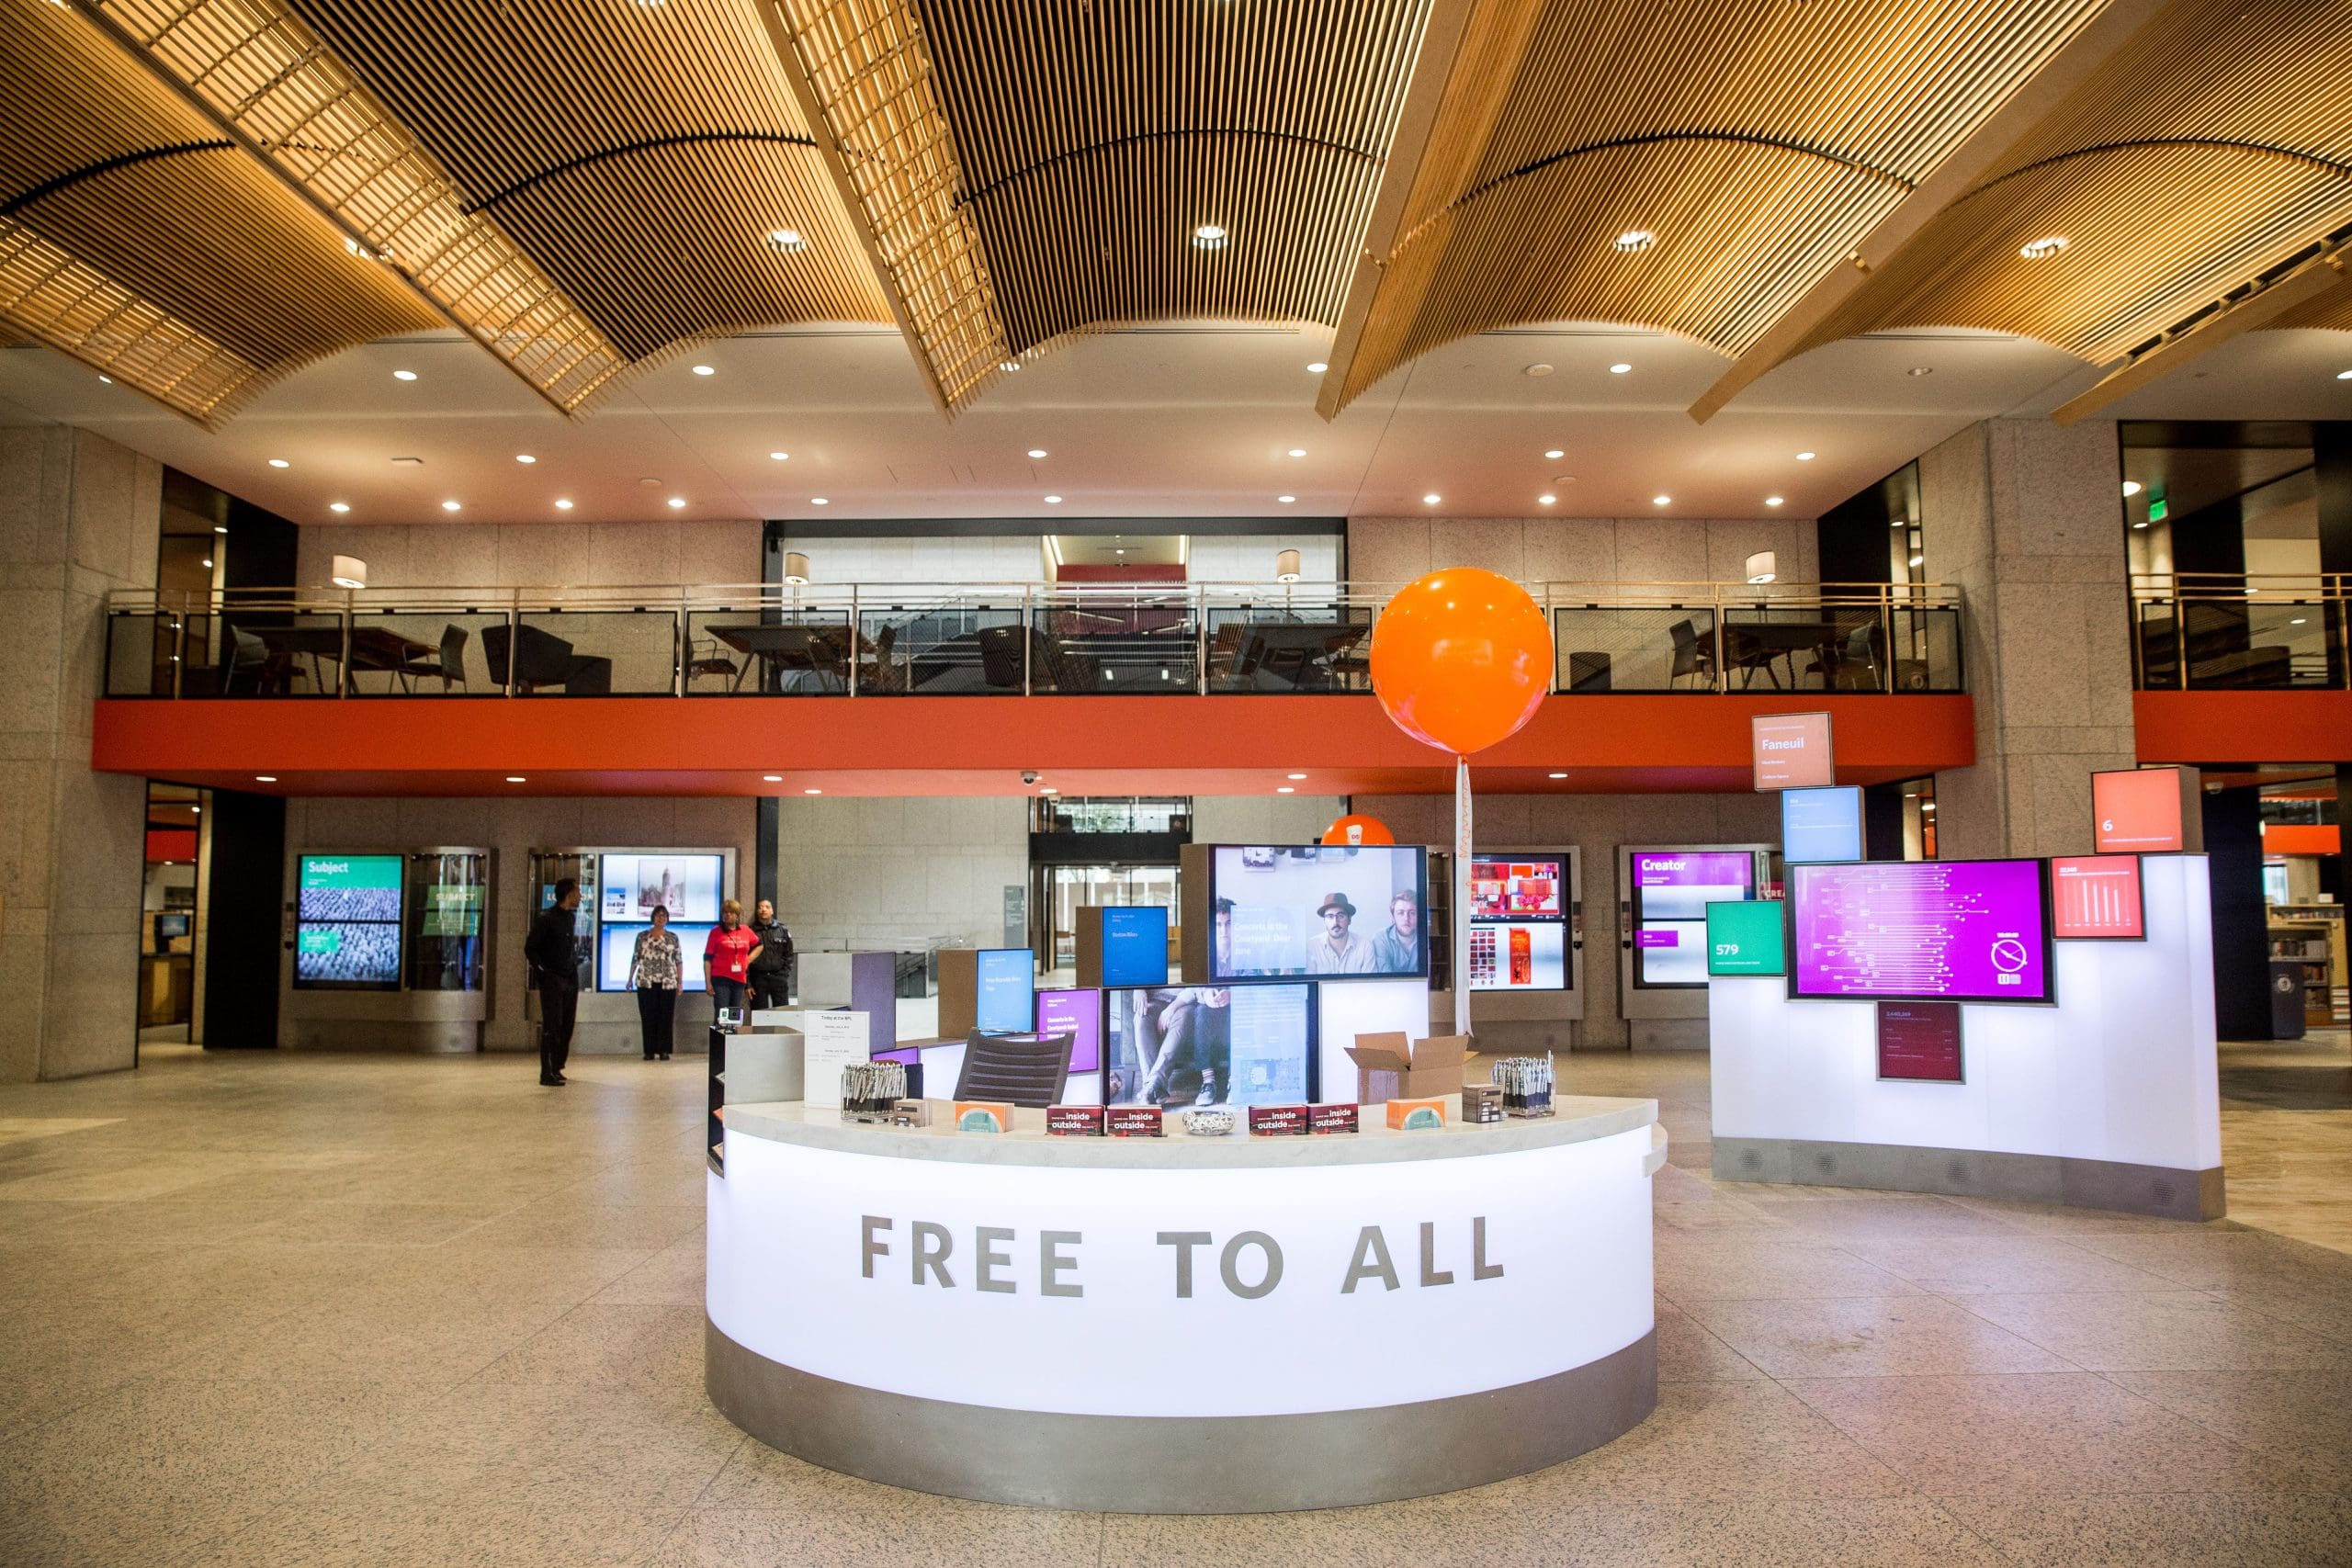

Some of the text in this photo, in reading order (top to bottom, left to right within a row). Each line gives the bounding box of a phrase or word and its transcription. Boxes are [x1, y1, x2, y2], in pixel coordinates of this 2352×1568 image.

[1761, 738, 1804, 750] Faneuil
[2102, 818, 2113, 832] 6
[308, 861, 349, 874] Subject
[1641, 859, 1686, 871] Creator
[1715, 943, 1739, 955] 579
[1066, 1112, 1091, 1121] inside
[1128, 1112, 1154, 1121] inside
[1272, 1111, 1296, 1120] inside
[1329, 1109, 1351, 1118] inside
[1051, 1121, 1082, 1129] outside
[1114, 1121, 1146, 1130] outside
[1257, 1121, 1288, 1130] outside
[1316, 1118, 1344, 1127] outside
[862, 1214, 1504, 1300] FREE TO ALL
